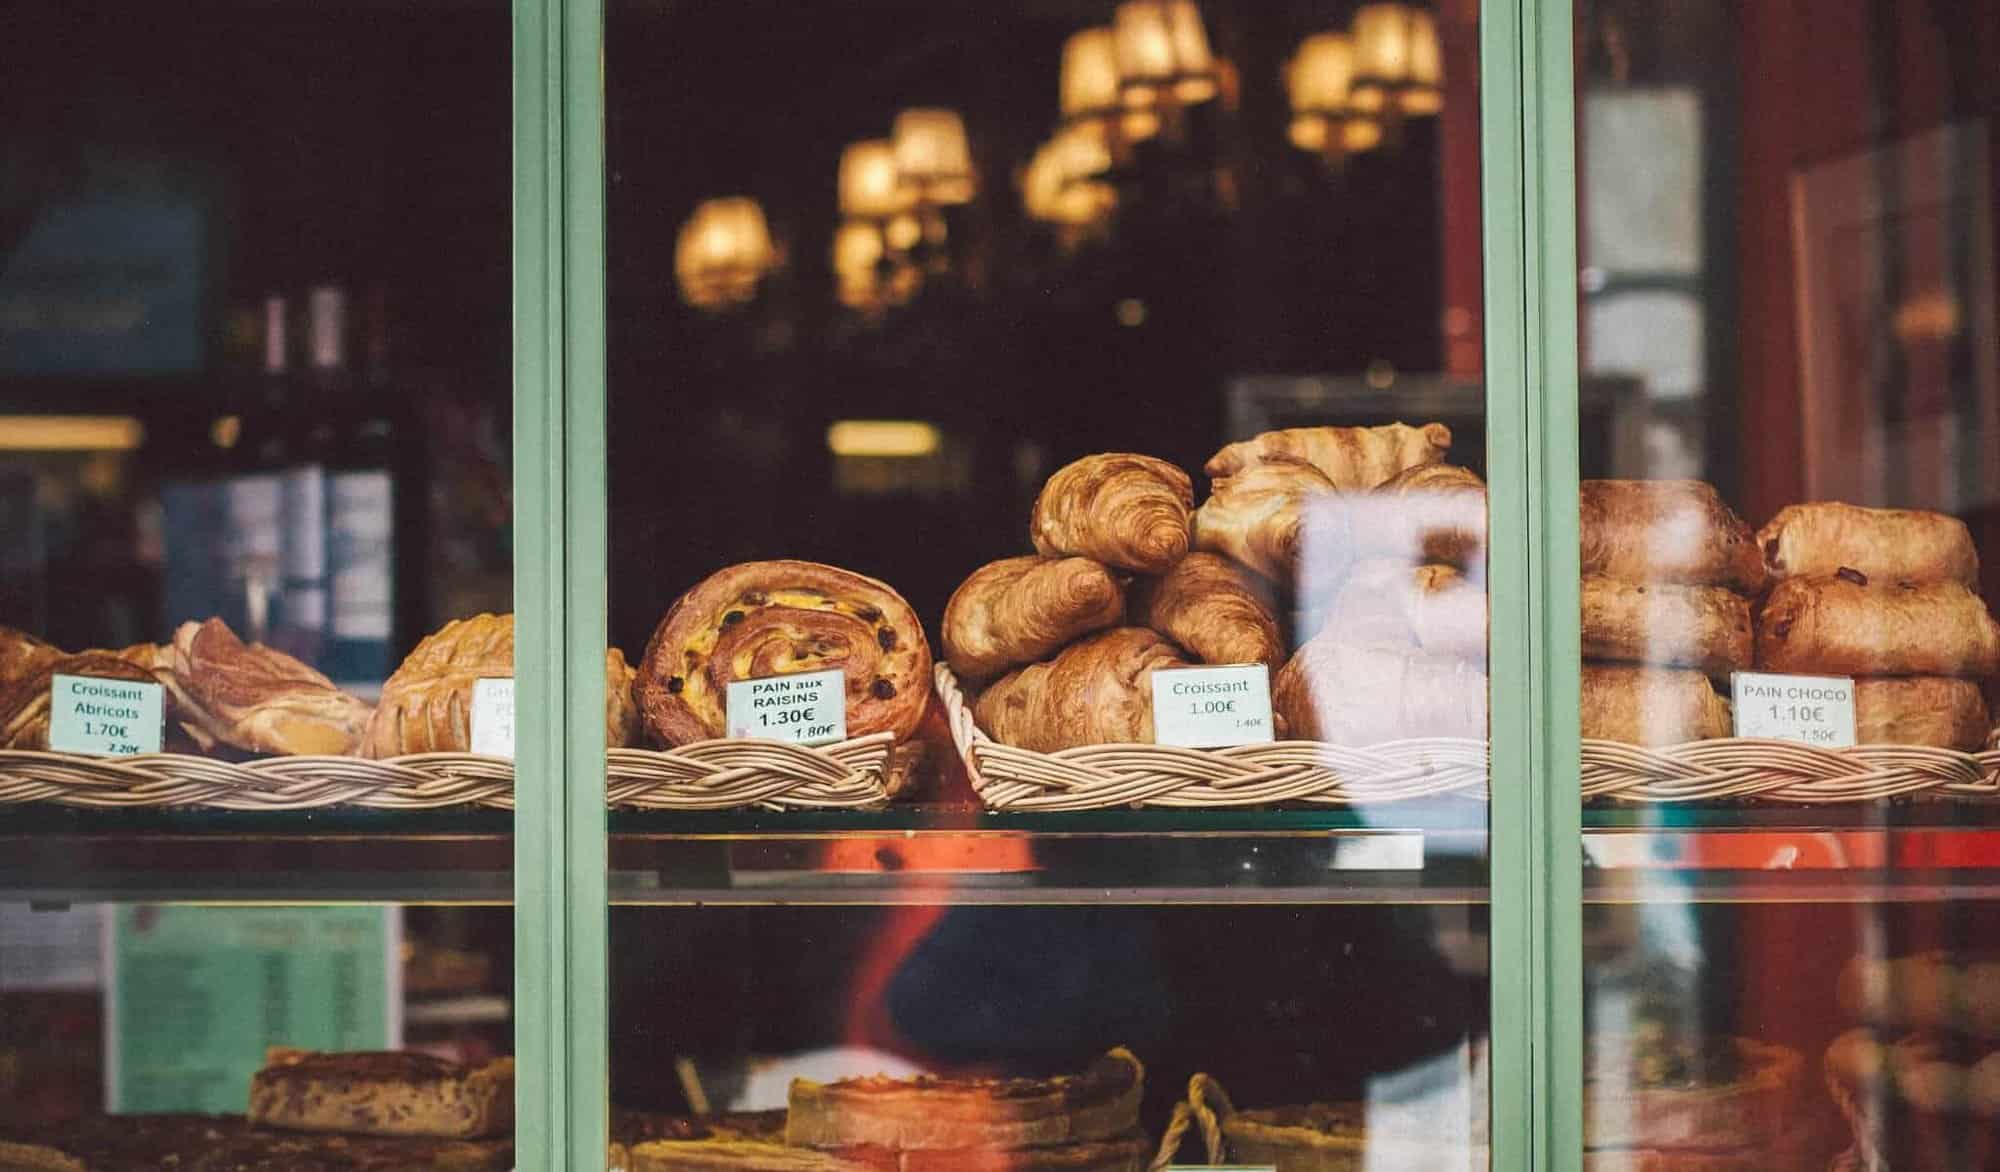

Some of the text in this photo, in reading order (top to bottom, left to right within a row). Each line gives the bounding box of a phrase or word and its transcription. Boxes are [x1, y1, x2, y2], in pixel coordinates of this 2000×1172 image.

[71, 682, 143, 701] Croissant
[753, 680, 823, 694] PAIN aux
[1172, 680, 1249, 695] Croissant
[1744, 686, 1847, 701] PAIN CHOCO
[754, 692, 819, 709] RAISINS
[1190, 700, 1237, 715] 1.00€
[75, 701, 139, 719] Abricots
[759, 708, 816, 727] 1.30€
[1769, 704, 1825, 723] 1.10€
[85, 722, 129, 738] 1.70€
[1235, 719, 1263, 728] 1.40€
[794, 724, 836, 739] 1.80€
[1800, 730, 1838, 741] 1.50€
